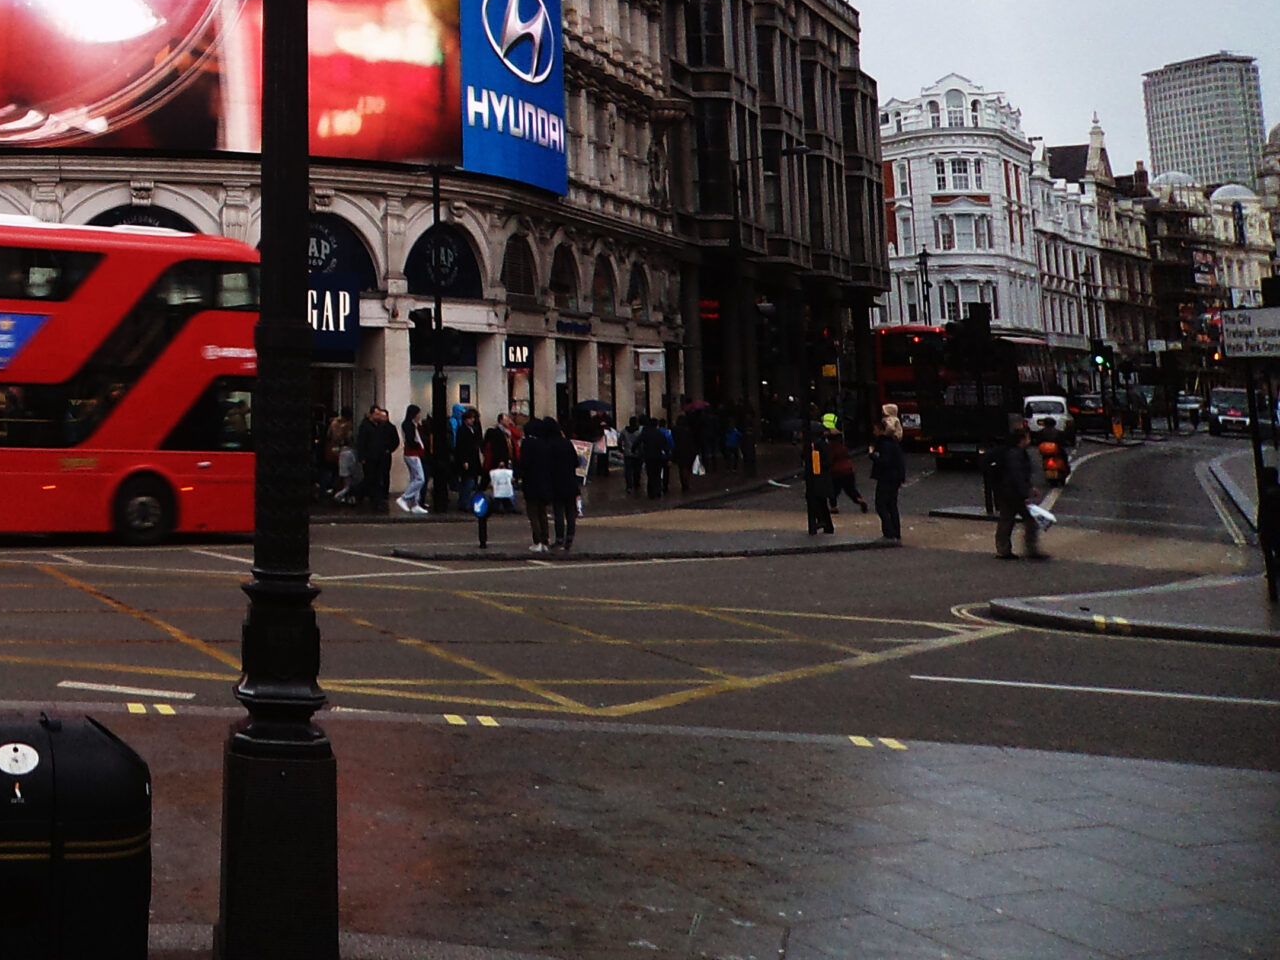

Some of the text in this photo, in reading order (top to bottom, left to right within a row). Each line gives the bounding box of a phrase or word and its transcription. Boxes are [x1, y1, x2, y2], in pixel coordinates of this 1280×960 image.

[466, 84, 565, 155] HYUNDAI
[308, 237, 331, 260] AP
[307, 289, 351, 332] GAP
[508, 345, 529, 363] GAP
